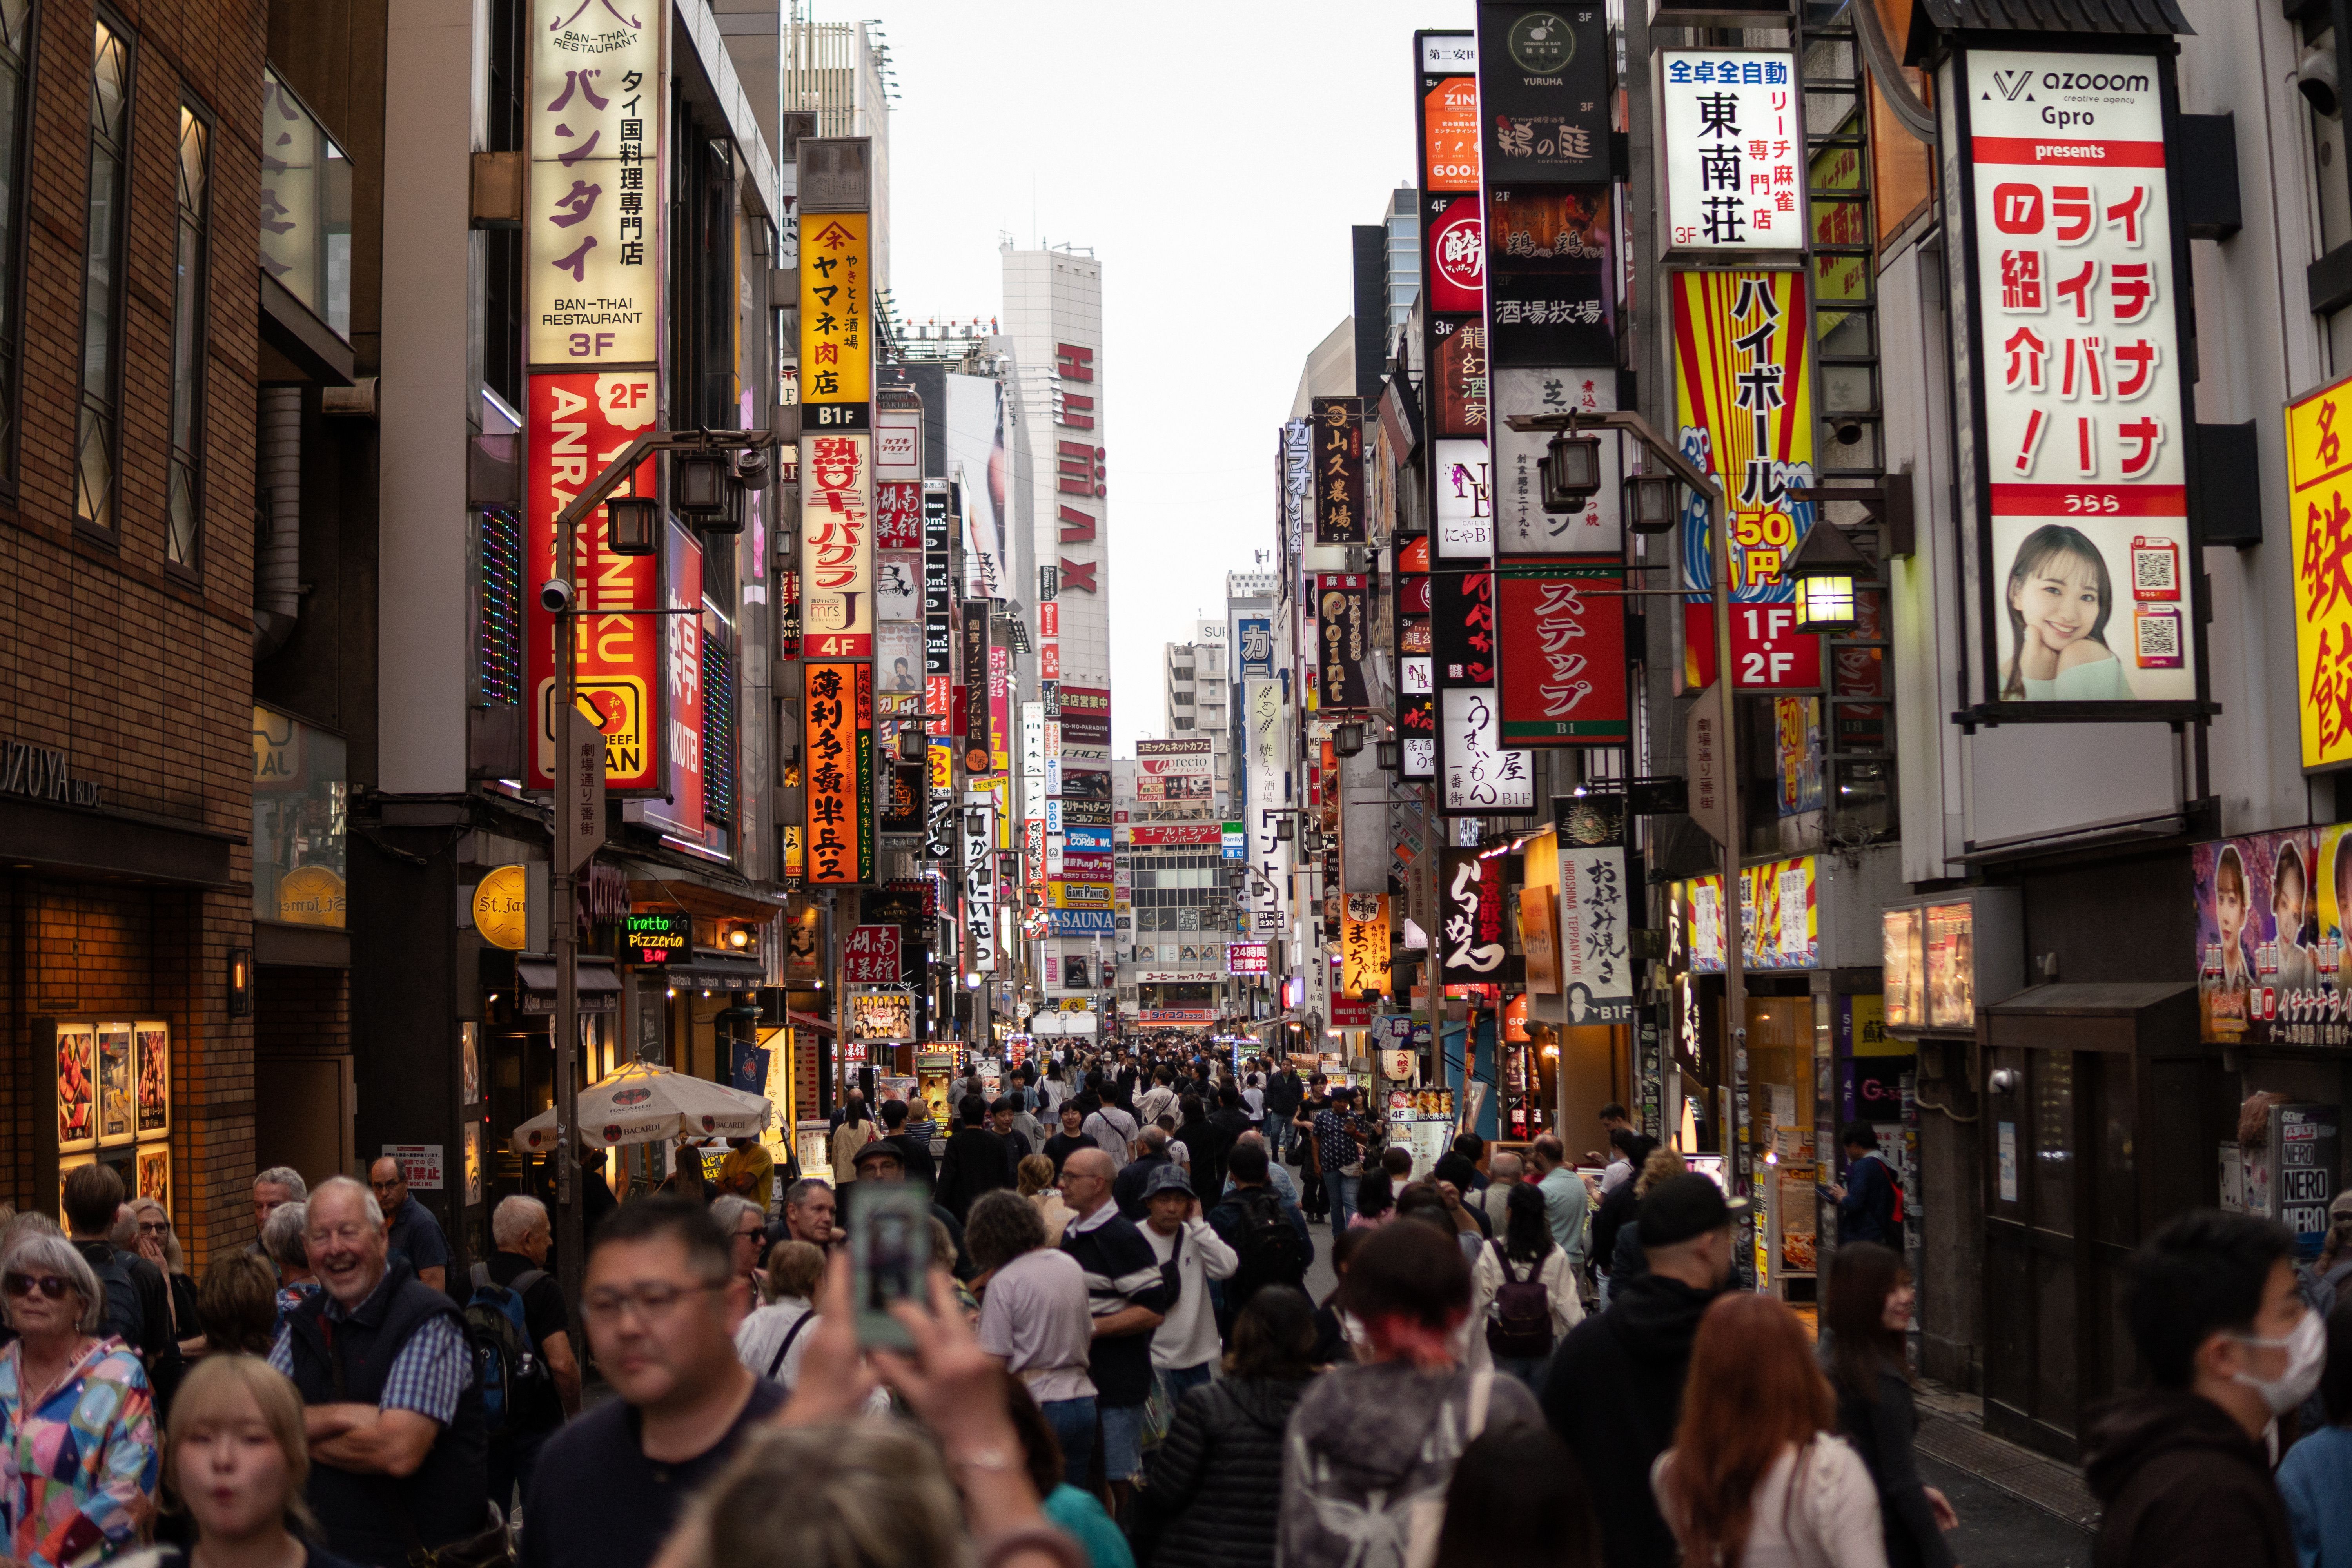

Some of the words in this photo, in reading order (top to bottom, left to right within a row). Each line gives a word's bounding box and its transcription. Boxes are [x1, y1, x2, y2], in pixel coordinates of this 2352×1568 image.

[1578, 13, 1592, 22] 3F
[553, 34, 638, 54] RESTAURANT
[563, 29, 628, 42] BAN-THAI
[1669, 60, 1788, 85] 全卓全自動
[2043, 72, 2149, 93] azooom
[1444, 94, 1477, 105] ZIN
[1580, 102, 1593, 112] 3F
[2042, 106, 2094, 129] Gpro
[1497, 122, 1593, 159] 鶏の庭
[1771, 91, 1795, 212] リーチ麻雀
[2036, 144, 2105, 160] presents
[547, 68, 610, 283] バンタイ
[619, 70, 643, 266] タイ国料理専門店
[1433, 164, 1471, 176] 600
[1695, 91, 1746, 245] 東南荘
[1748, 139, 1772, 230] 専門店
[1431, 200, 1446, 212] 4F
[1495, 191, 1510, 201] 2F
[1675, 227, 1697, 243] 3F
[1445, 264, 1472, 274] すいげつ
[554, 299, 633, 310] BAN-THAI
[843, 254, 859, 350] やきとん酒場
[542, 312, 643, 326] RESTAURANT
[1495, 300, 1604, 325] 酒場牧場
[810, 256, 840, 396] ヤマネ肉店
[1435, 321, 1453, 334] 3F
[2052, 185, 2102, 471] ライバー
[2106, 185, 2159, 474] イチナナ
[569, 333, 615, 357] 3F
[1460, 325, 1486, 426] 龍幻酒家
[610, 383, 649, 409] 2F
[1730, 277, 1787, 506] ハイボール
[818, 407, 853, 425] B1F
[1327, 430, 1352, 528] 山久農場
[1517, 454, 1529, 540] 創業昭和二十九年
[2064, 495, 2120, 512] うらら
[807, 437, 869, 589] 熟女キャバクラ
[1735, 511, 1791, 547] 50
[1746, 548, 1782, 586] 円
[1326, 575, 1356, 587] 麻雀
[833, 592, 866, 630] J
[1348, 595, 1362, 661] MAHJONG
[1743, 609, 1792, 640] 1F
[821, 637, 855, 655] 4F
[1323, 592, 1347, 702] Point
[1533, 583, 1592, 717] ステップ
[1742, 653, 1794, 684] 2F
[858, 669, 871, 721] 炭火串焼
[1060, 693, 1108, 710] 全店営業中
[609, 696, 620, 724] 和牛
[1061, 723, 1108, 731] MO-MO-PARADISE
[1555, 723, 1575, 734] B1
[1062, 749, 1110, 759] FACE
[1138, 742, 1210, 752] コミック&ネットカフェ
[1463, 695, 1497, 805] うまいもん
[1155, 755, 1207, 773] aprecio
[1259, 743, 1275, 803] 焼とん酒場
[1495, 751, 1527, 781] 屋
[1697, 718, 1713, 810] 劇場通り一番街
[75, 779, 102, 808] BLDG
[581, 743, 595, 836] 劇場通り一番街
[973, 779, 1007, 790] 今すぐ見つかる
[1449, 765, 1464, 806] 一番街
[1062, 800, 1111, 813] ビリヤード&ダーツ
[1502, 792, 1530, 806] B1F
[1049, 802, 1057, 830] GiGO
[1076, 815, 1093, 823] ゴルフ
[861, 817, 871, 866] 楽しいお店
[1162, 835, 1201, 843] ハンバーグ
[1226, 849, 1234, 858] 酒
[1063, 858, 1076, 867] 東京
[1077, 858, 1093, 870] Ping
[1066, 885, 1083, 898] GAME
[1084, 885, 1103, 899] PANIC
[1414, 868, 1423, 917] 劇場通り一番街
[1564, 860, 1577, 911] HIROSHIMA
[1350, 900, 1378, 914] 新宿
[628, 916, 688, 932] Trattoria
[1062, 912, 1114, 928] SAUNA
[1583, 858, 1627, 984] お好み焼き
[629, 933, 684, 948] Pizzeria
[1370, 925, 1379, 974] 九州のうまかもん
[643, 948, 668, 963] Bar
[1233, 947, 1267, 958] 24時間
[1349, 924, 1370, 991] まっちゃん
[1233, 958, 1267, 970] 営業中
[1196, 972, 1217, 980] クール
[1205, 1009, 1212, 1020] 免税
[1600, 1005, 1633, 1020] B1F
[1394, 1019, 1410, 1034] 麻
[715, 1120, 745, 1129] BACARDÍ
[1391, 1111, 1405, 1119] 4F
[624, 1122, 661, 1135] BACARDÍ
[2284, 1144, 2313, 1164] NERO
[2284, 1170, 2326, 1200] NERO
